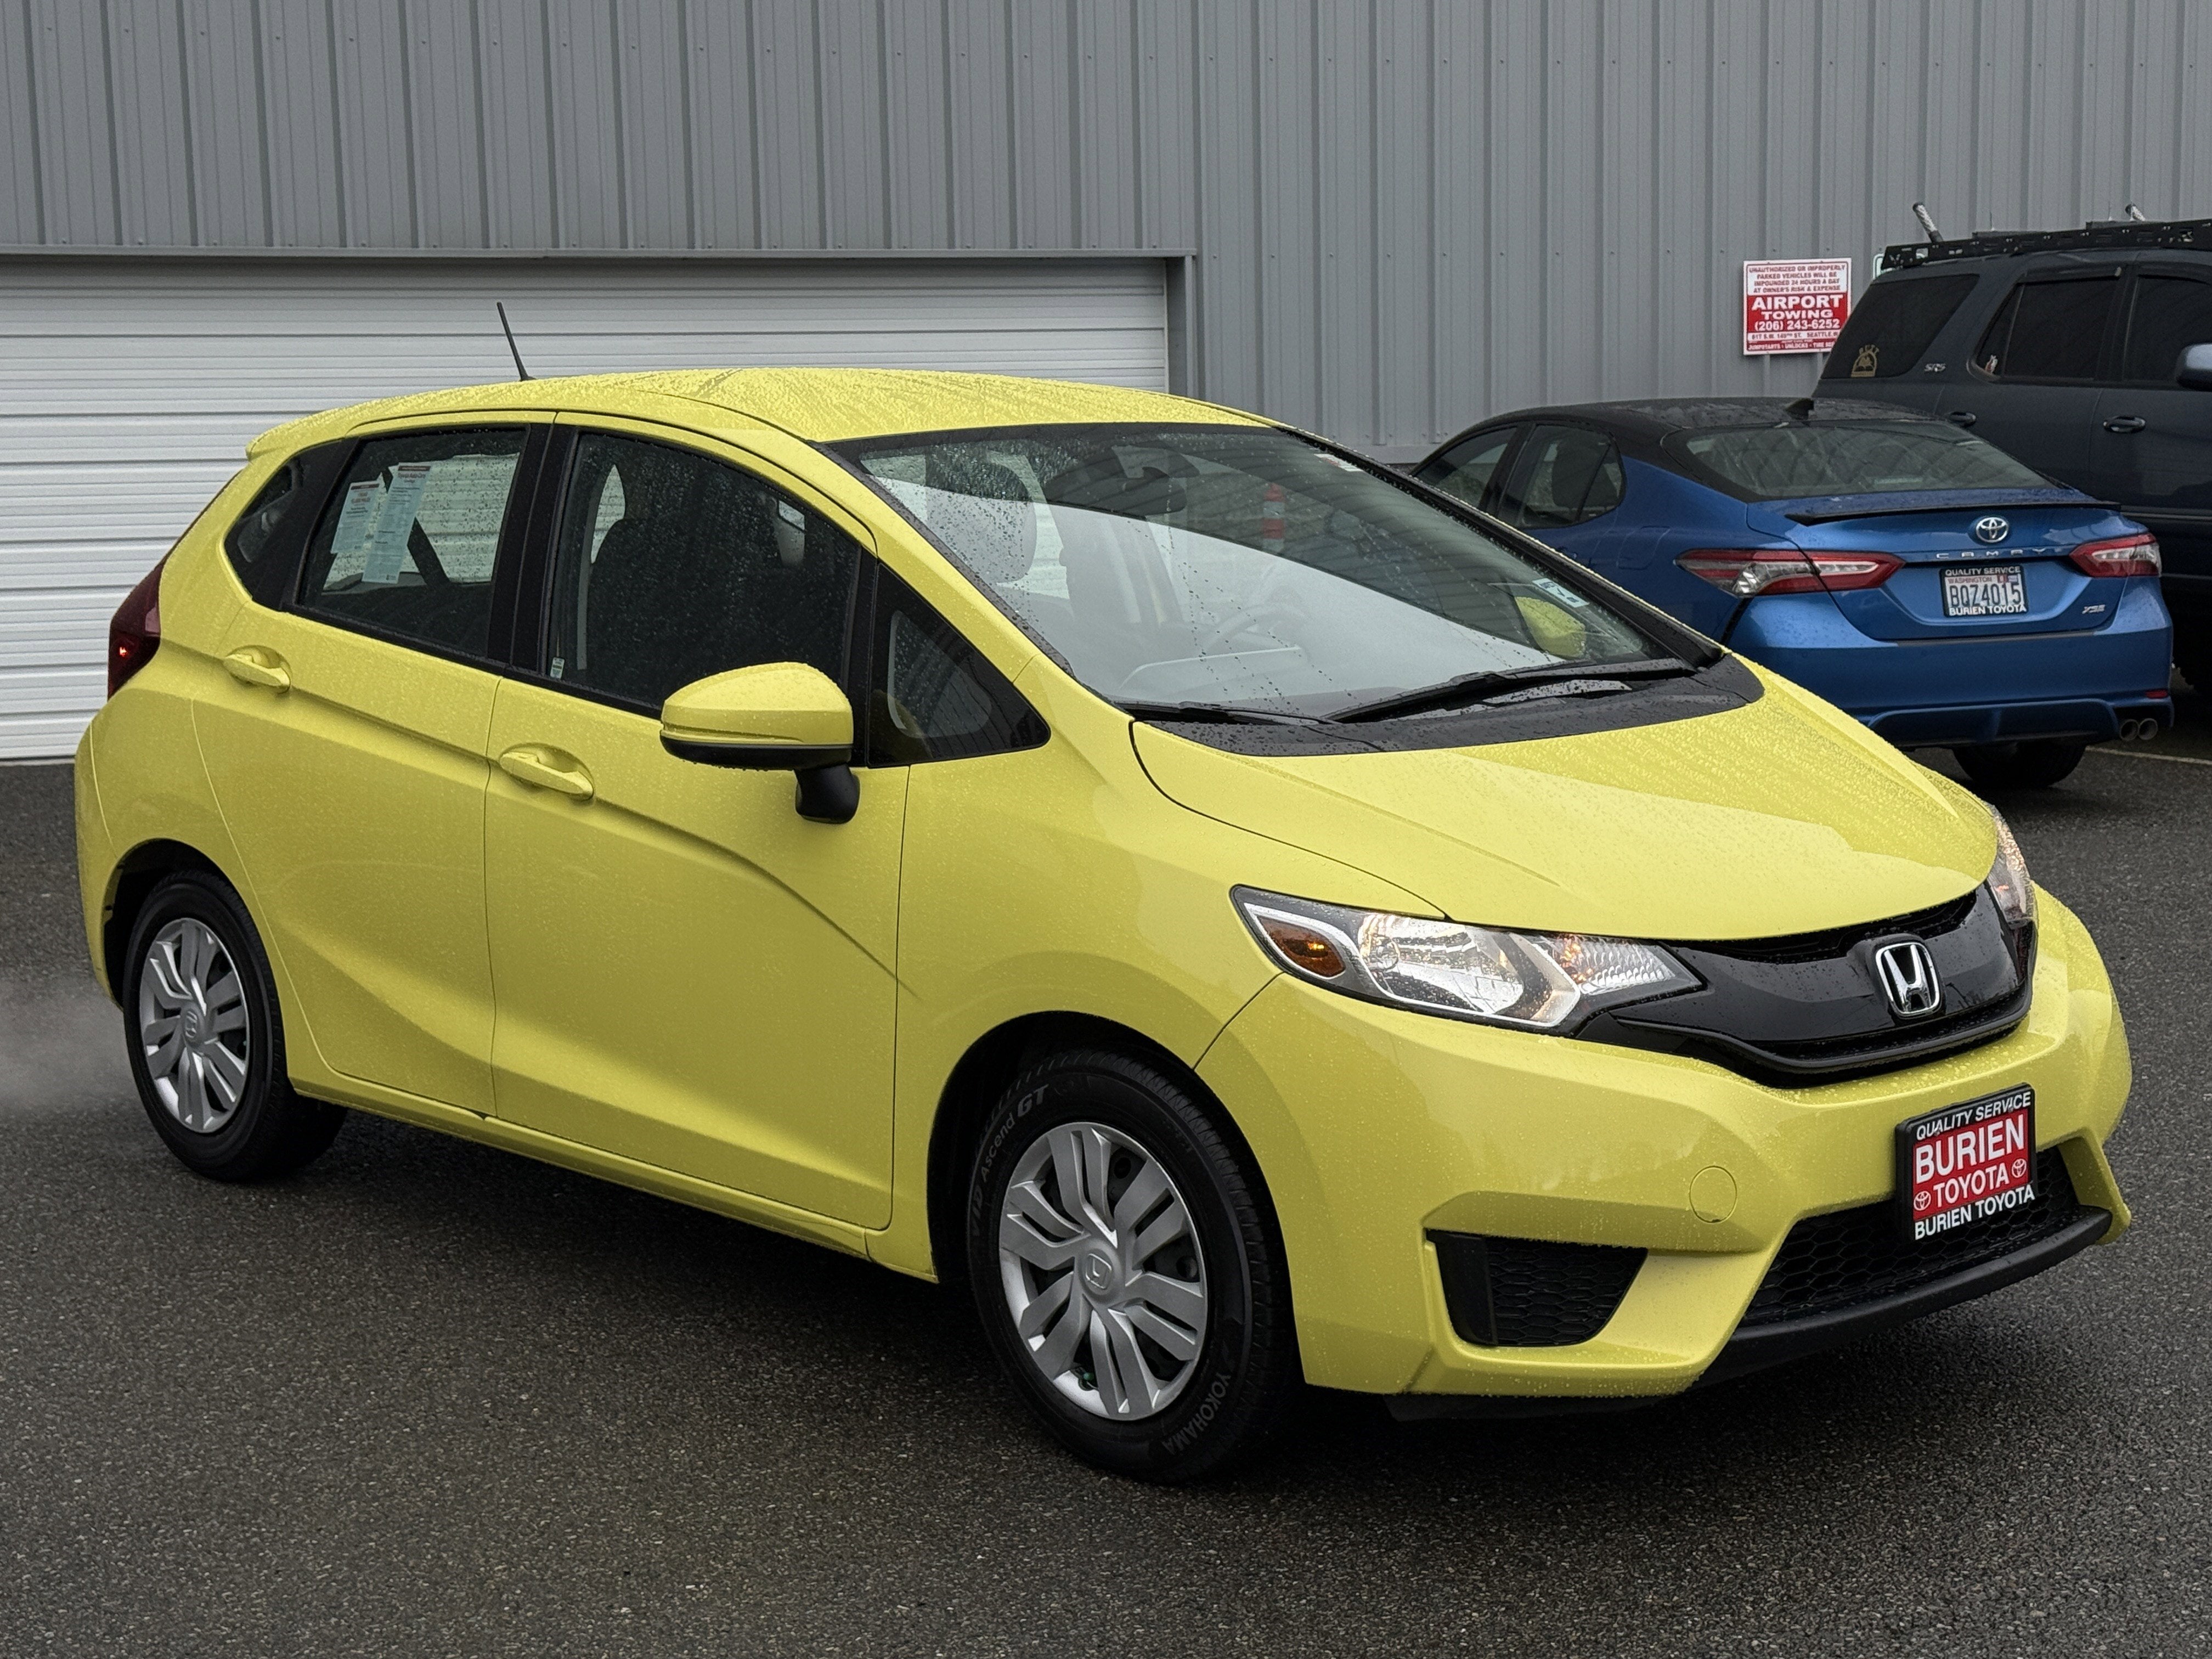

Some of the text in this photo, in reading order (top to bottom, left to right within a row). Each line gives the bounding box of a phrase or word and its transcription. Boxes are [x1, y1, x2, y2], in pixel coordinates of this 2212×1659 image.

[1752, 295, 1843, 310] AIRPORT
[1761, 309, 1833, 320] TOWING
[1755, 319, 1840, 331] (206) 243-6252
[1936, 548, 2046, 558] CAMRY
[1945, 568, 1982, 576] QUALITY
[1949, 604, 2027, 616] BURIEN TOYOTA
[1916, 1092, 2031, 1141] QUALITY SERVICE
[981, 1113, 1015, 1182] Ascend
[1017, 1084, 1049, 1117] GT
[1916, 1114, 2024, 1184] BURIEN
[1933, 1163, 2010, 1207] TOYOTA
[1915, 1184, 2035, 1240] BURIEN TOYOTA
[1161, 1372, 1232, 1455] YOKOHAMA
